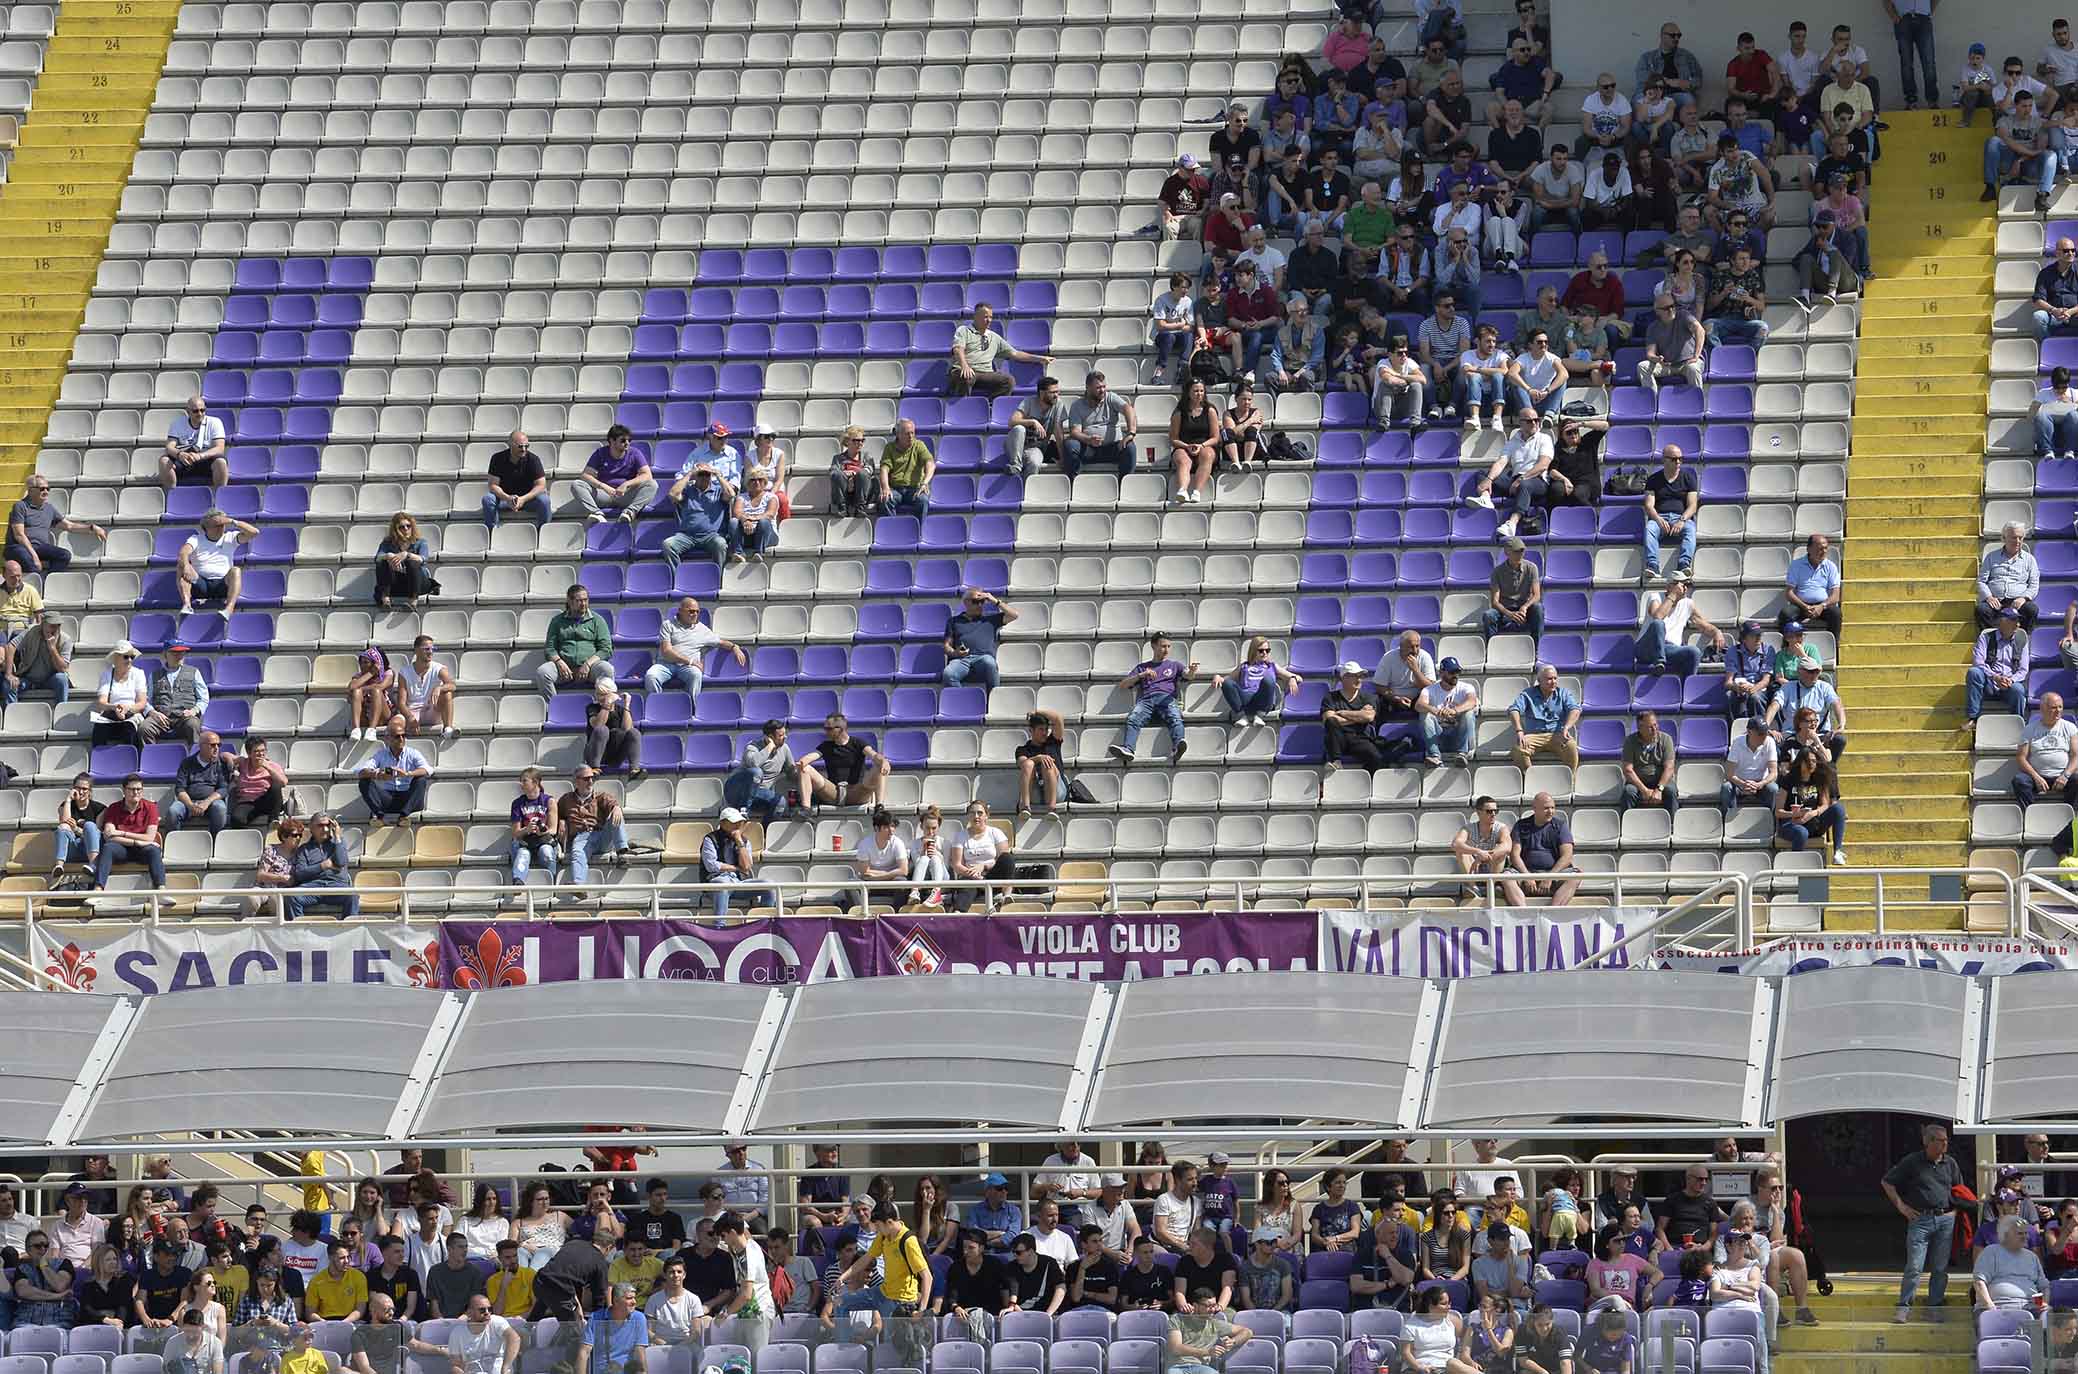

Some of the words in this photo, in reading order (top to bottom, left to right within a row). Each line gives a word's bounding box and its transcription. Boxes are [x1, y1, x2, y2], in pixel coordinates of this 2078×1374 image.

[116, 3, 132, 15] 25
[104, 39, 121, 50] 24
[91, 75, 108, 87] 23
[82, 112, 99, 124] 22
[1932, 114, 1948, 127] 21
[70, 148, 86, 160] 21
[1929, 151, 1946, 164] 20
[58, 184, 74, 196] 20
[1929, 187, 1945, 200] 19
[46, 221, 63, 233] 19
[1925, 224, 1942, 237] 18
[34, 258, 50, 270] 18
[1923, 263, 1938, 276] 17
[21, 296, 37, 309] 17
[1921, 301, 1938, 313] 16
[9, 335, 26, 347] 16
[1918, 342, 1934, 355] 15
[1915, 381, 1931, 393] 14
[1017, 924, 1099, 955] VIOLA
[1110, 923, 1181, 953] CLUB
[1769, 941, 1825, 953] centro
[1833, 939, 1969, 953] coordinamento
[1978, 941, 2022, 953] viola
[2030, 943, 2068, 956] club
[751, 966, 798, 983] CLUB
[1875, 1335, 1886, 1351] 5
